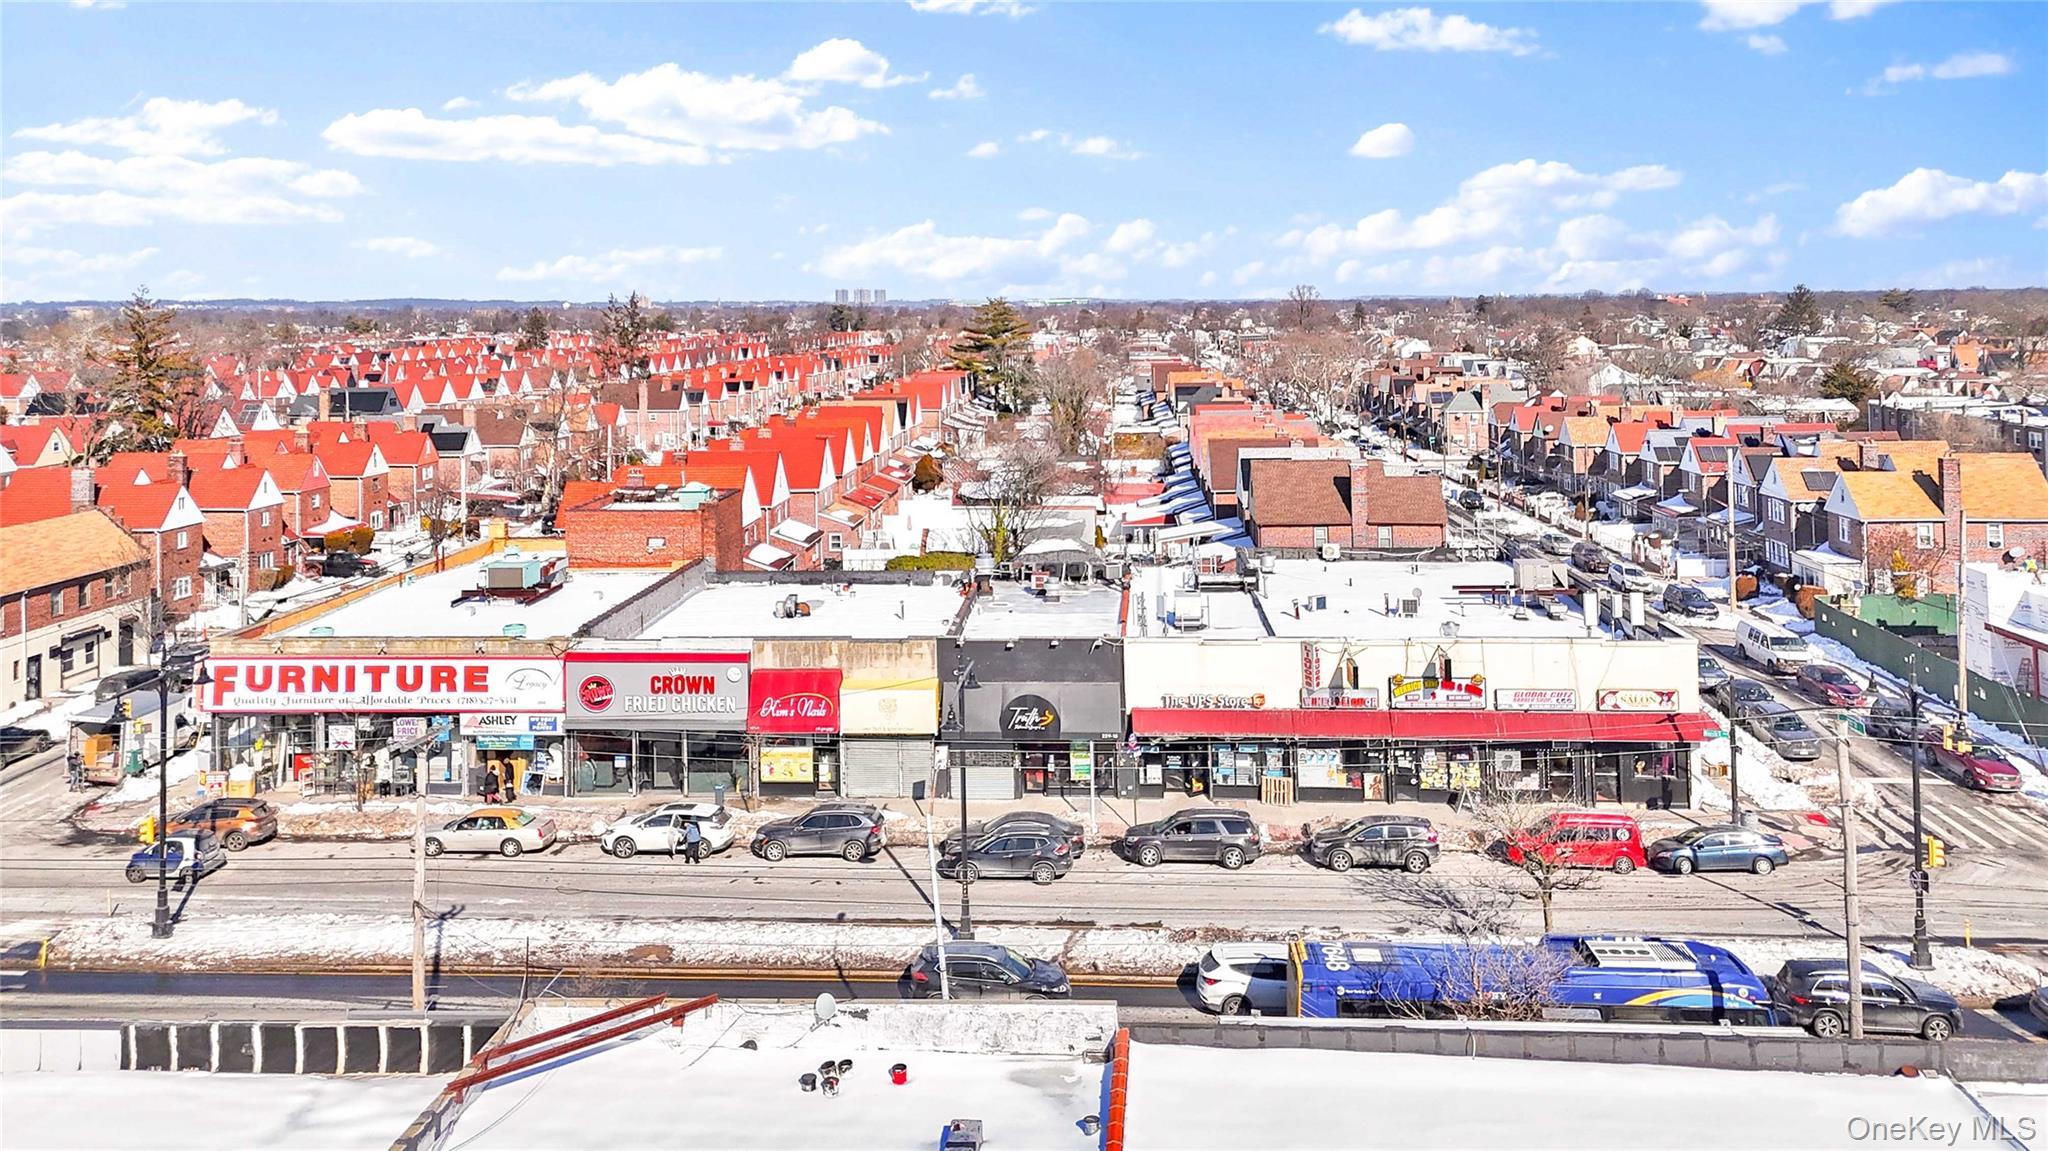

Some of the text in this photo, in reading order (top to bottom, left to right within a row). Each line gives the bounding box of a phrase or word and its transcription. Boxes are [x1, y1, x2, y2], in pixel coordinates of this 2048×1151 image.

[213, 665, 489, 706] FURNITURE
[513, 675, 549, 691] Legacy
[650, 675, 715, 695] CROWN
[233, 696, 277, 706] Quality
[281, 696, 334, 706] Furniture
[354, 695, 413, 705] Affordable
[417, 696, 451, 705] Prices
[624, 695, 667, 713] FRIED
[671, 696, 736, 714] CHICKEN
[759, 697, 828, 717] Kim's Nails
[1161, 694, 1185, 709] The
[1187, 694, 1213, 709] UPS
[1214, 694, 1248, 709] Store
[479, 715, 517, 725] ASHLEY
[1008, 707, 1041, 729] Truth
[1319, 941, 1351, 971] 7648
